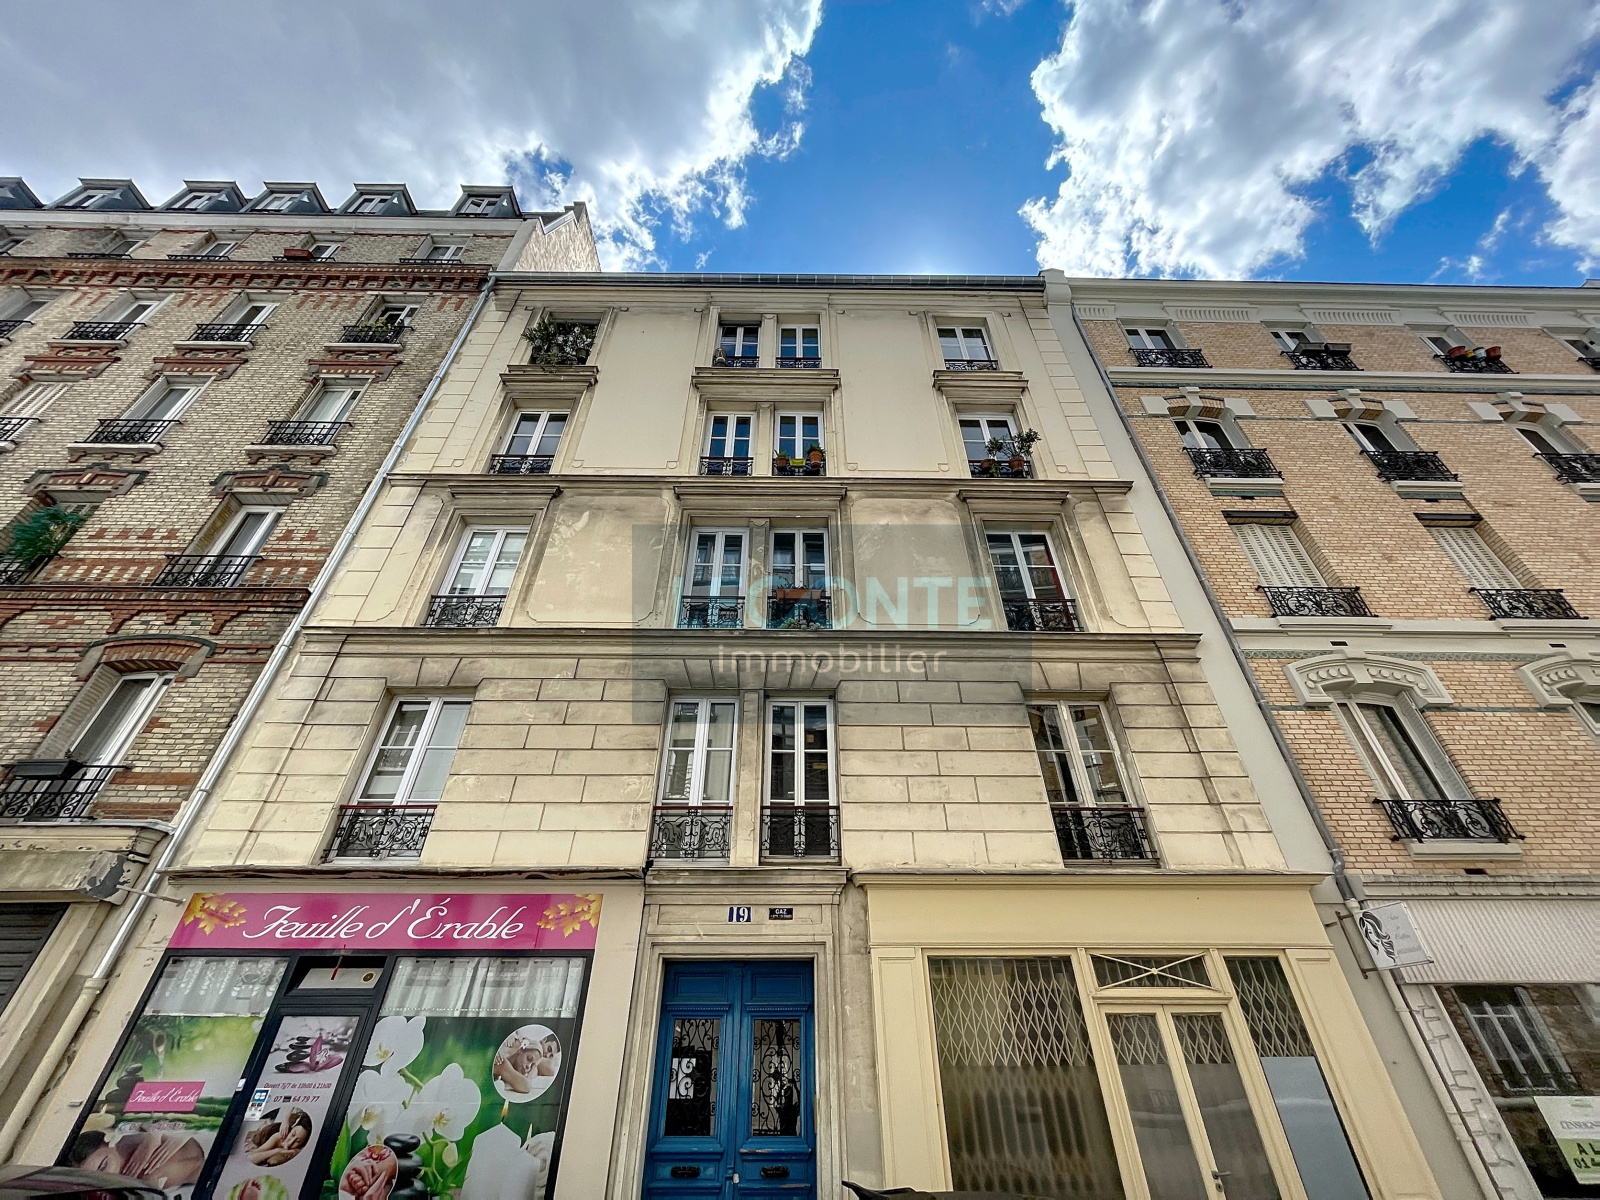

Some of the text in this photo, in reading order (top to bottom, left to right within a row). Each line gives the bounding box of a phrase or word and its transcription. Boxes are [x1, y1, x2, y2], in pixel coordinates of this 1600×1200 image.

[243, 898, 527, 939] Feuille d'Érable
[732, 907, 749, 922] 19
